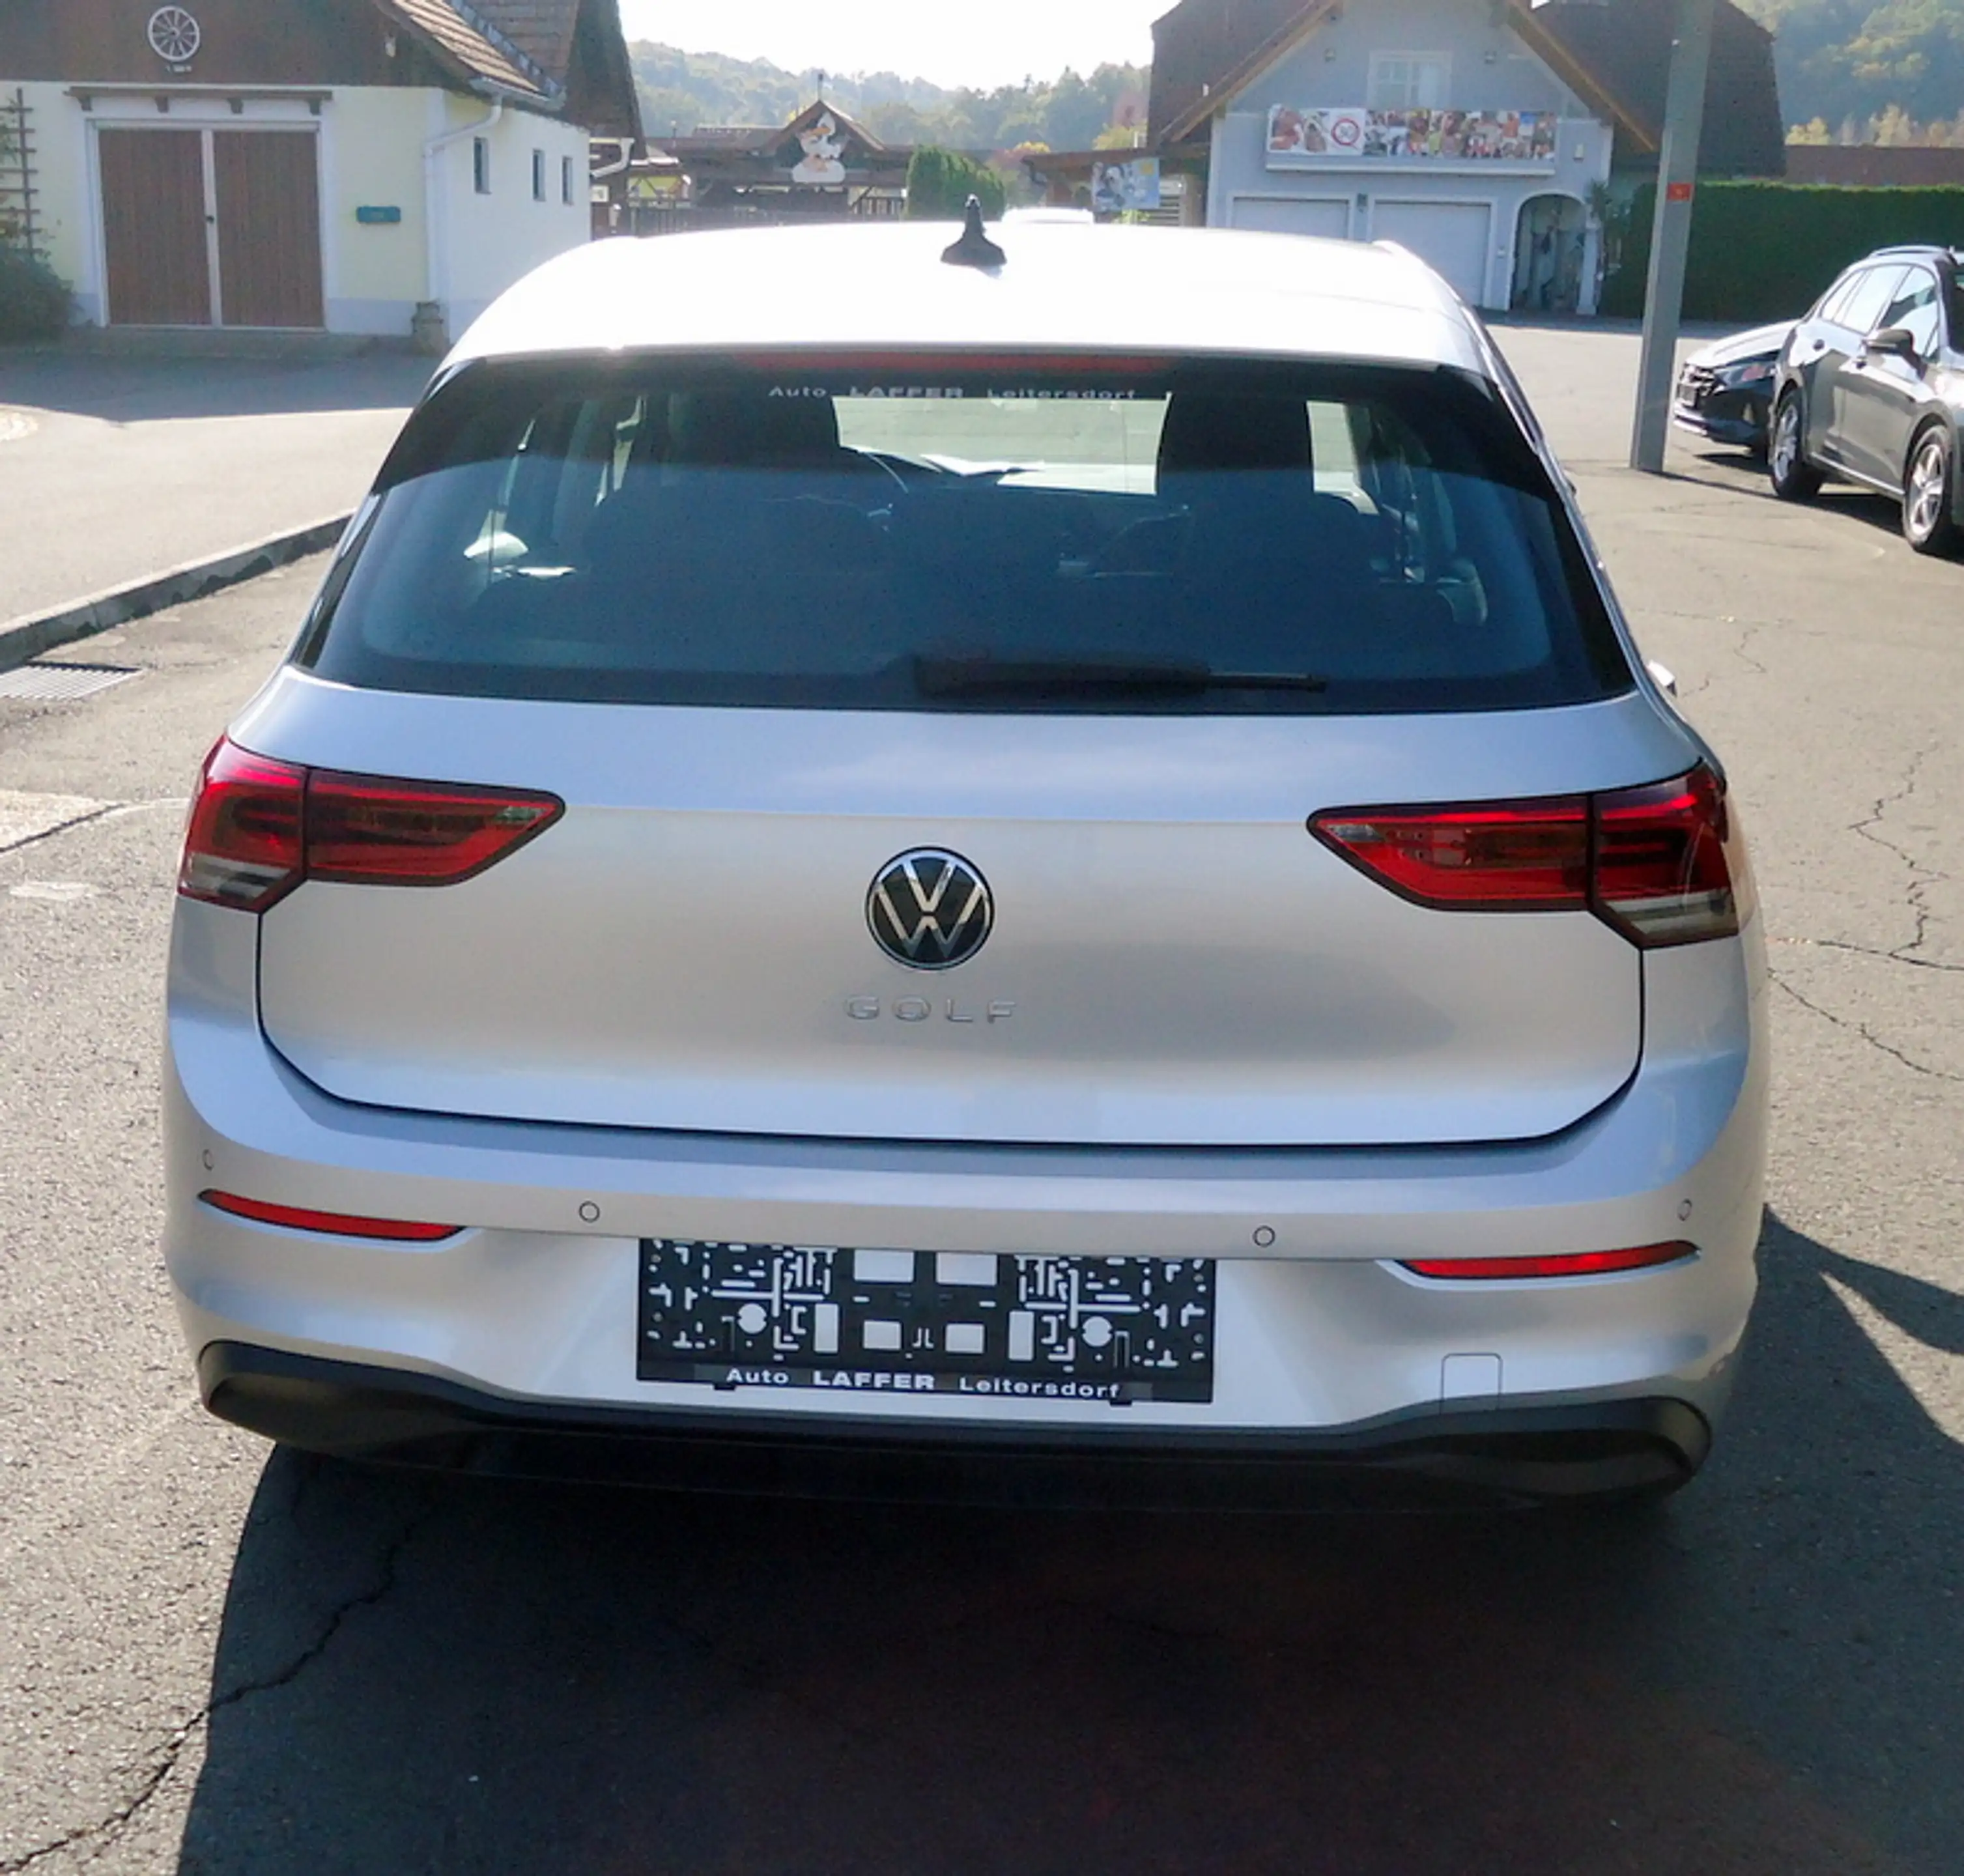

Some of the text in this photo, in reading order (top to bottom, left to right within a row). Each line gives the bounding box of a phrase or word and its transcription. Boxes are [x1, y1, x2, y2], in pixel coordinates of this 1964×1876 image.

[768, 385, 1135, 399] Auto LAFFER Leitersdorf
[870, 851, 989, 965] VW
[845, 994, 1017, 1024] GOLF
[726, 1367, 1120, 1399] Auto LAFFER Leitersdorf
